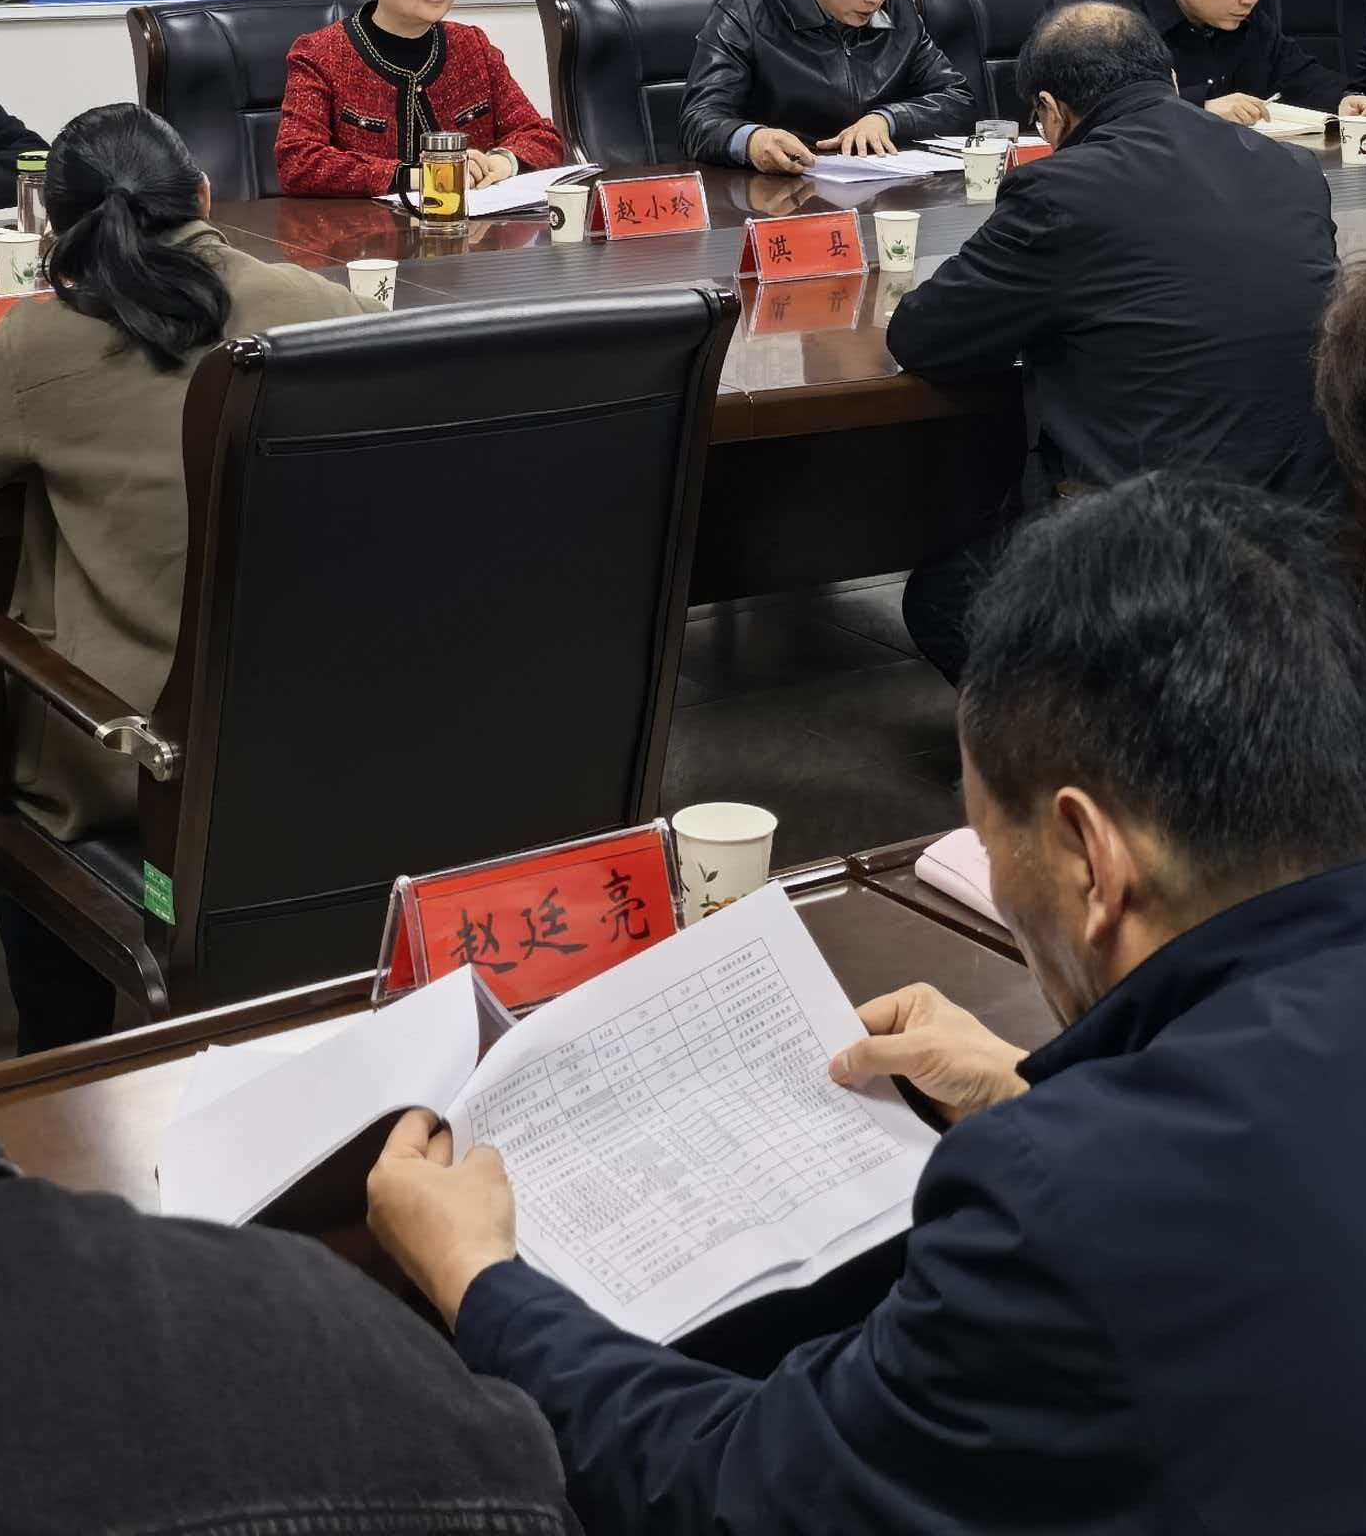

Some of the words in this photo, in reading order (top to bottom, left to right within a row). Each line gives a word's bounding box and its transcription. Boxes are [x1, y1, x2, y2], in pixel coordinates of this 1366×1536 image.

[614, 191, 695, 226] 赵小玲
[768, 229, 851, 265] 淇县
[450, 867, 651, 976] 赵廷亮
